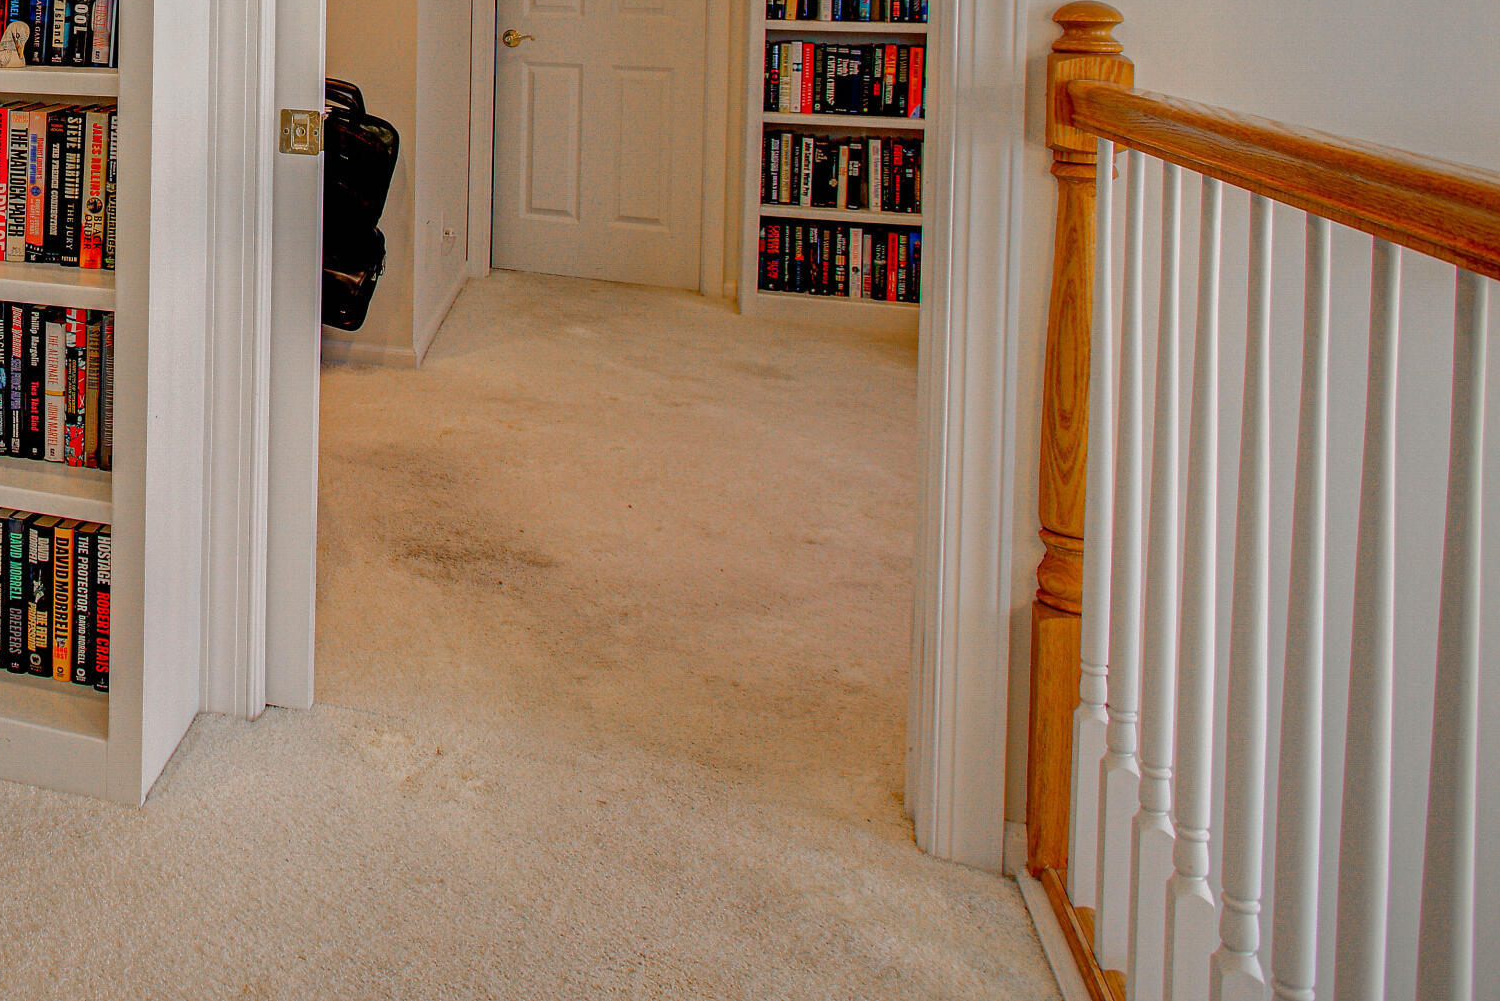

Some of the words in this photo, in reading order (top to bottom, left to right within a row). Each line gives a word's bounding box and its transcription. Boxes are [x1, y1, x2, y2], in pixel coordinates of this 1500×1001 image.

[10, 128, 28, 149] THE
[9, 150, 27, 201] MATLOCK
[8, 203, 25, 237] PAPER
[93, 216, 102, 250] BLACK
[10, 532, 22, 558] DAVID
[78, 536, 89, 555] THE
[9, 561, 22, 600] MORRELL
[77, 557, 88, 612] PROTECTOR
[96, 591, 110, 636] ROBERT
[96, 637, 109, 673] CRAIS
